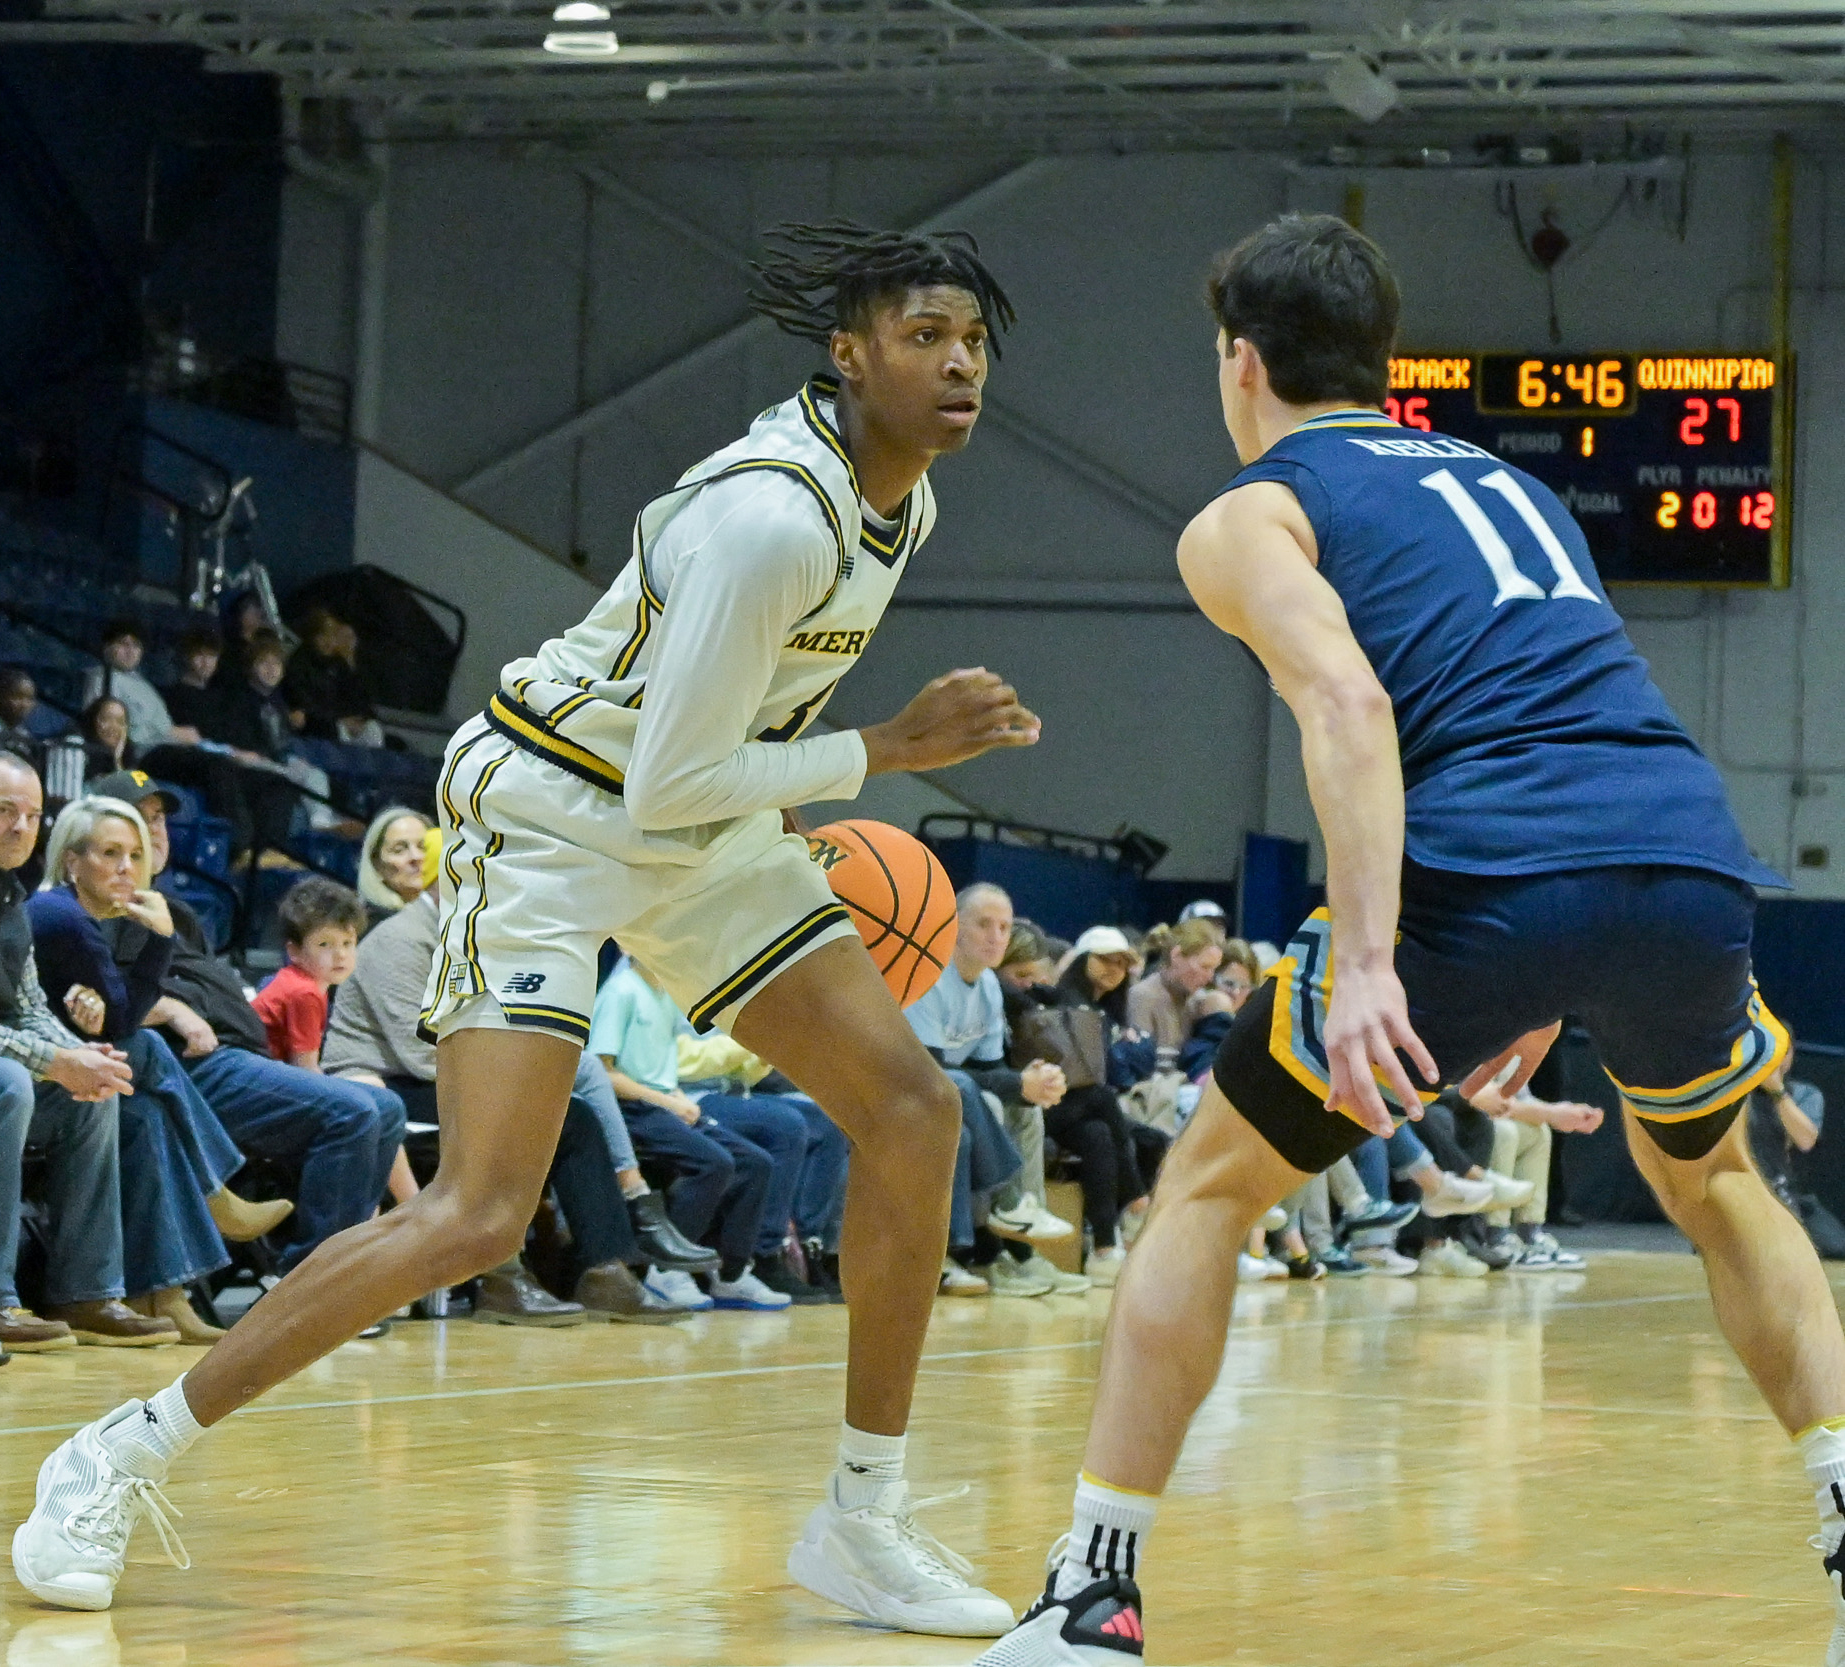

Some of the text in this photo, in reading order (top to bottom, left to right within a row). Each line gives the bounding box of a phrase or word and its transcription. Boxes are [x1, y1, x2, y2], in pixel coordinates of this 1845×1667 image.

[1518, 360, 1626, 408] 6:46
[1581, 426, 1595, 458] 1
[1680, 398, 1741, 445] 27
[1657, 491, 1681, 529] 2
[1739, 491, 1775, 529] 12
[1419, 468, 1602, 608] 11
[783, 627, 874, 655] MER
